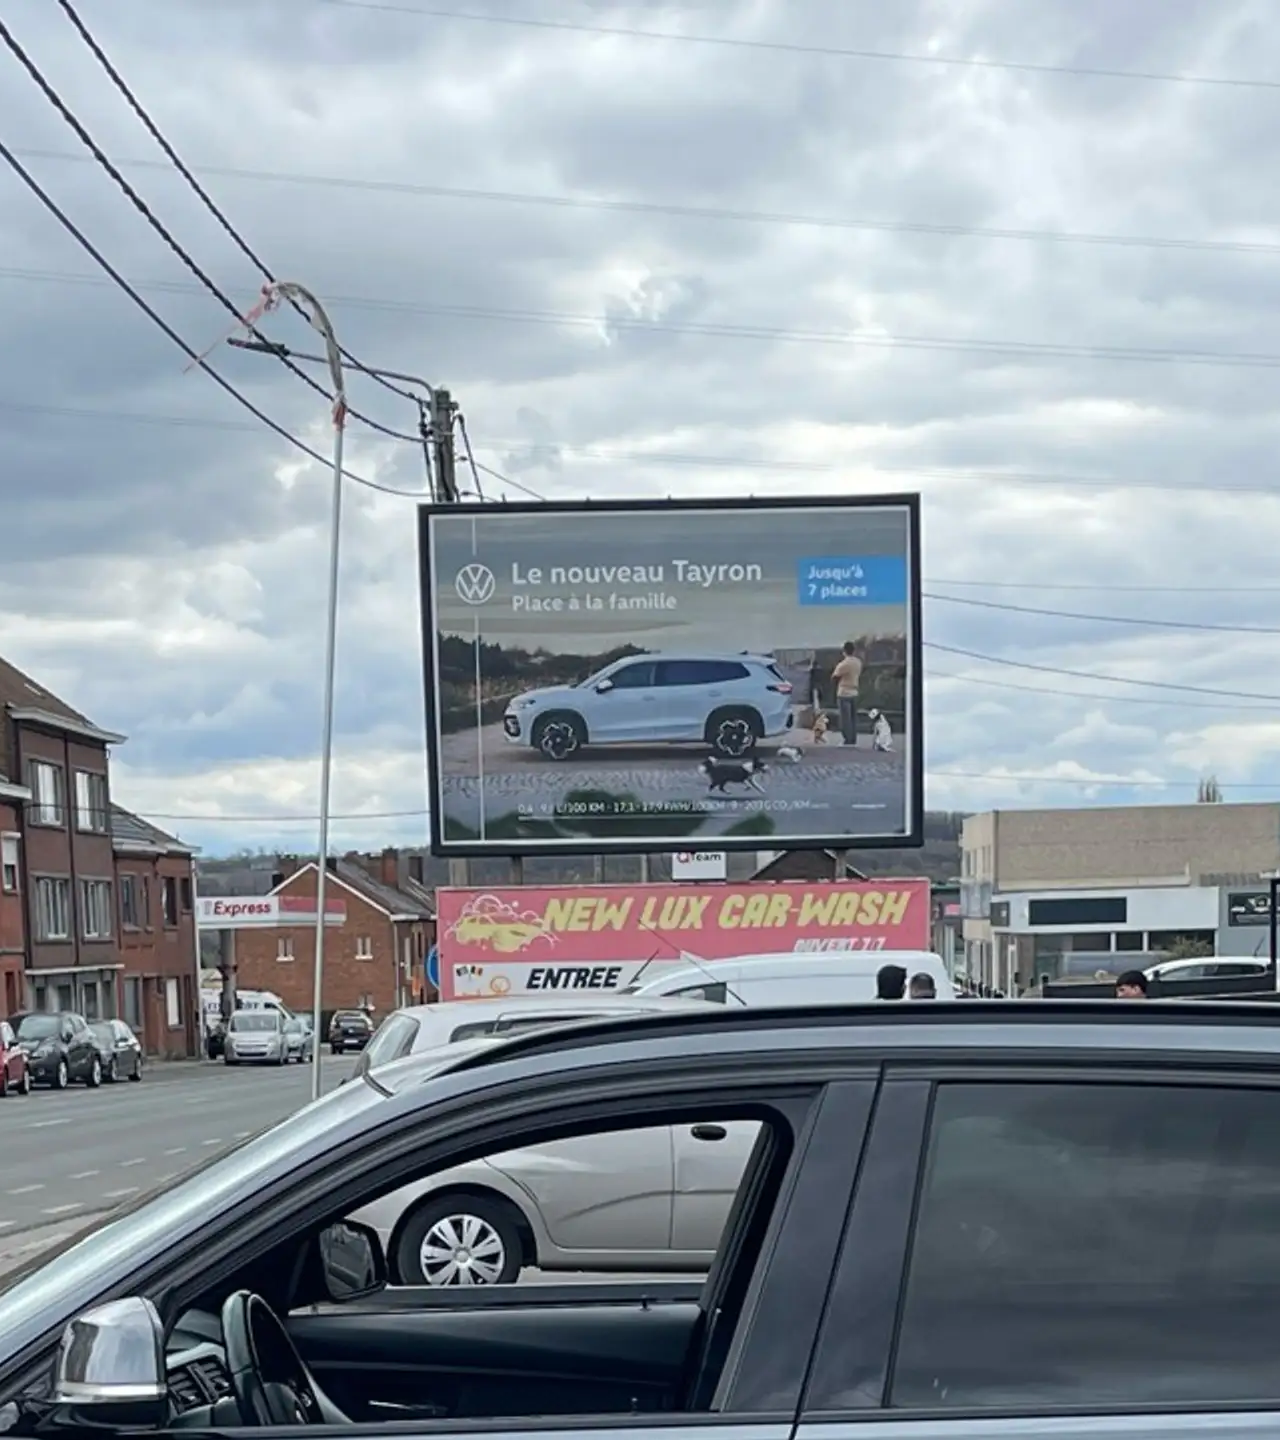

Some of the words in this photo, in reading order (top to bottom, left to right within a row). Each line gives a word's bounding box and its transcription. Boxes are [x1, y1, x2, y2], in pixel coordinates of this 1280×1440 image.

[511, 562, 542, 585] Le
[550, 562, 664, 584] nouveau
[672, 559, 762, 587] Tayron
[807, 563, 864, 581] Jusqu'à
[512, 595, 563, 612] Place
[568, 593, 580, 611] à
[586, 593, 603, 610] la
[609, 591, 678, 610] famille
[807, 583, 818, 597] 7
[821, 583, 868, 600] places
[214, 901, 272, 916] Express
[543, 897, 633, 931] NEW
[638, 895, 712, 930] LUX
[718, 891, 911, 930] CAR-WASH
[526, 966, 622, 990] ENTREE
